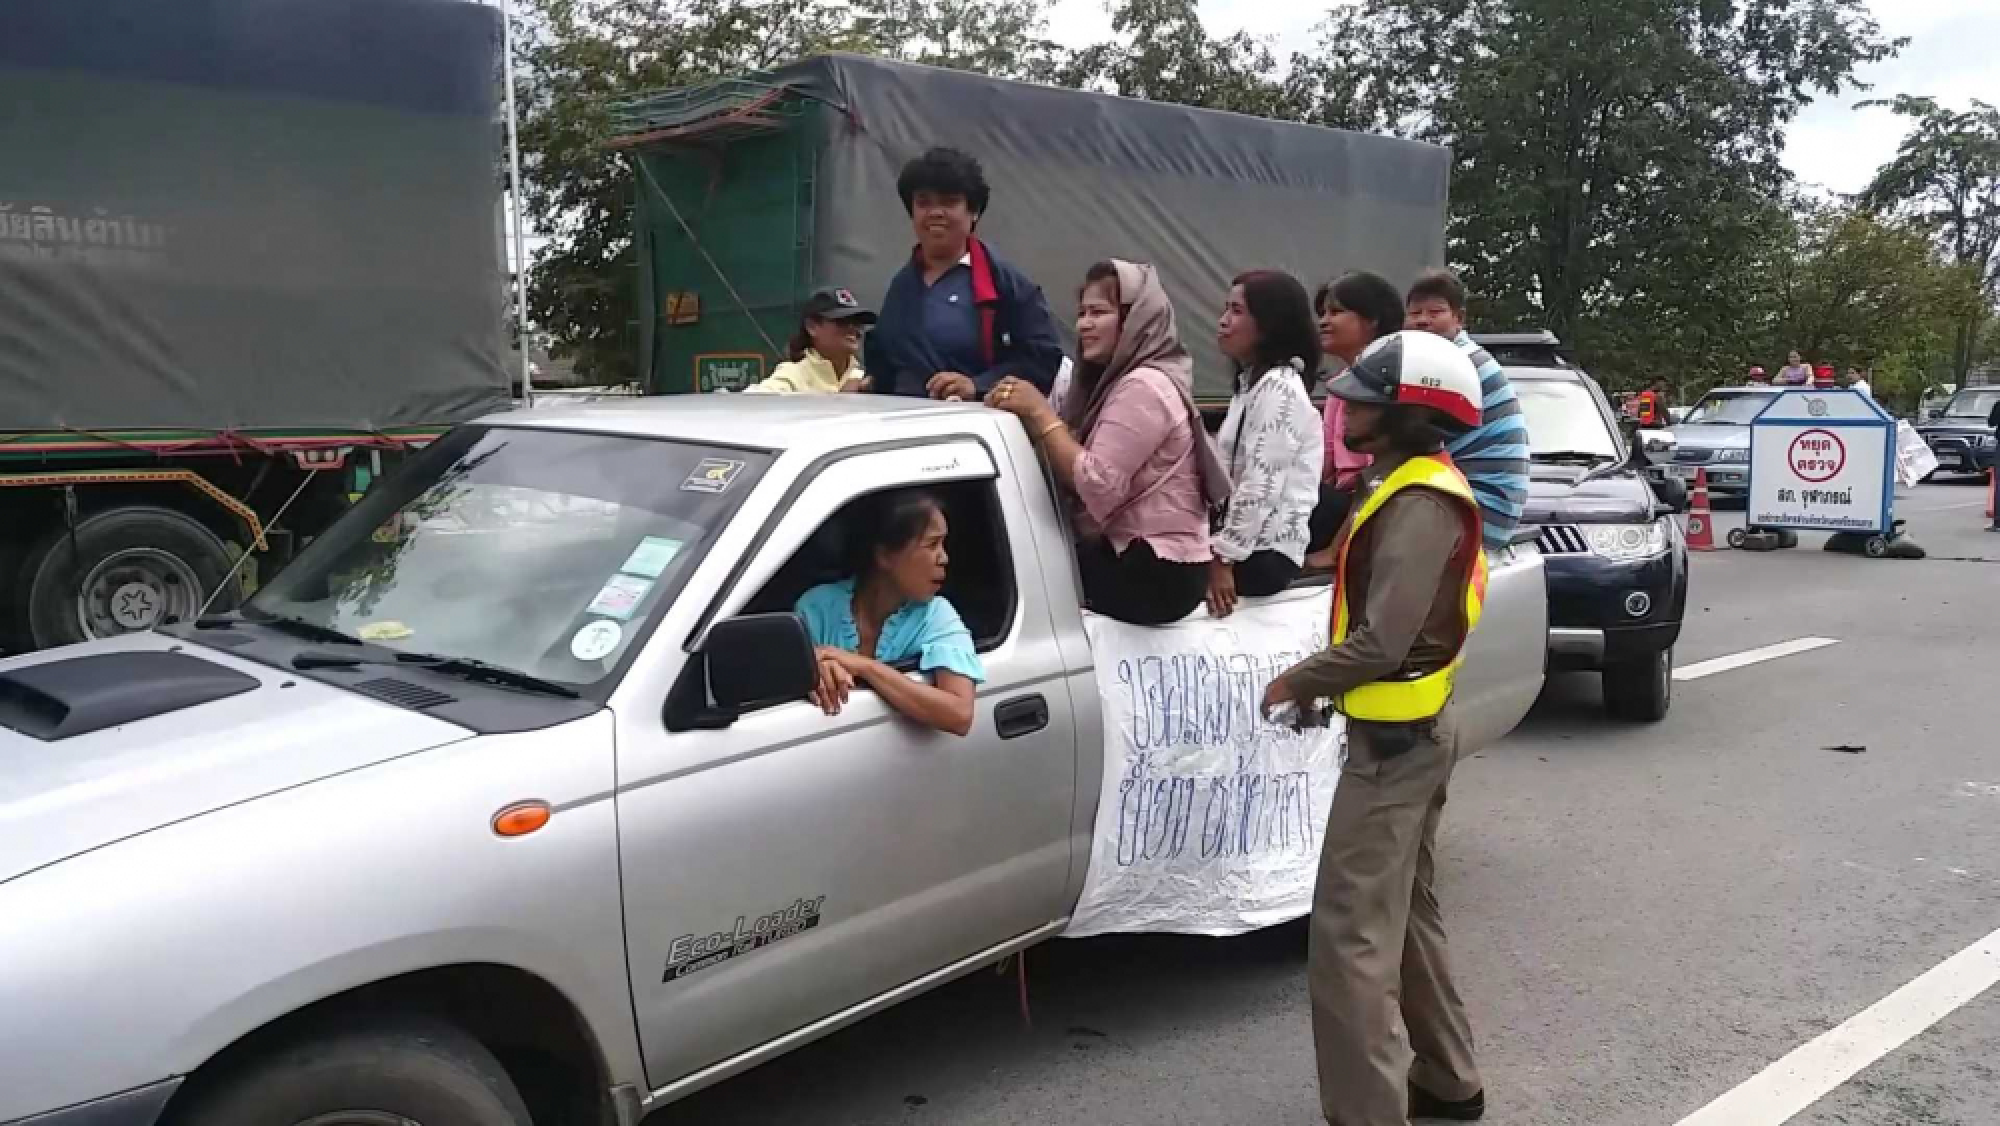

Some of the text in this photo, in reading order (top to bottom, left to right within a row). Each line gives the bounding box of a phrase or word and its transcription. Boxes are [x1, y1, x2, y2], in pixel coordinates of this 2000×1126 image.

[1799, 439, 1831, 457] หยุด
[1797, 459, 1836, 471] ตรวจ
[666, 894, 827, 966] Eco-Loader
